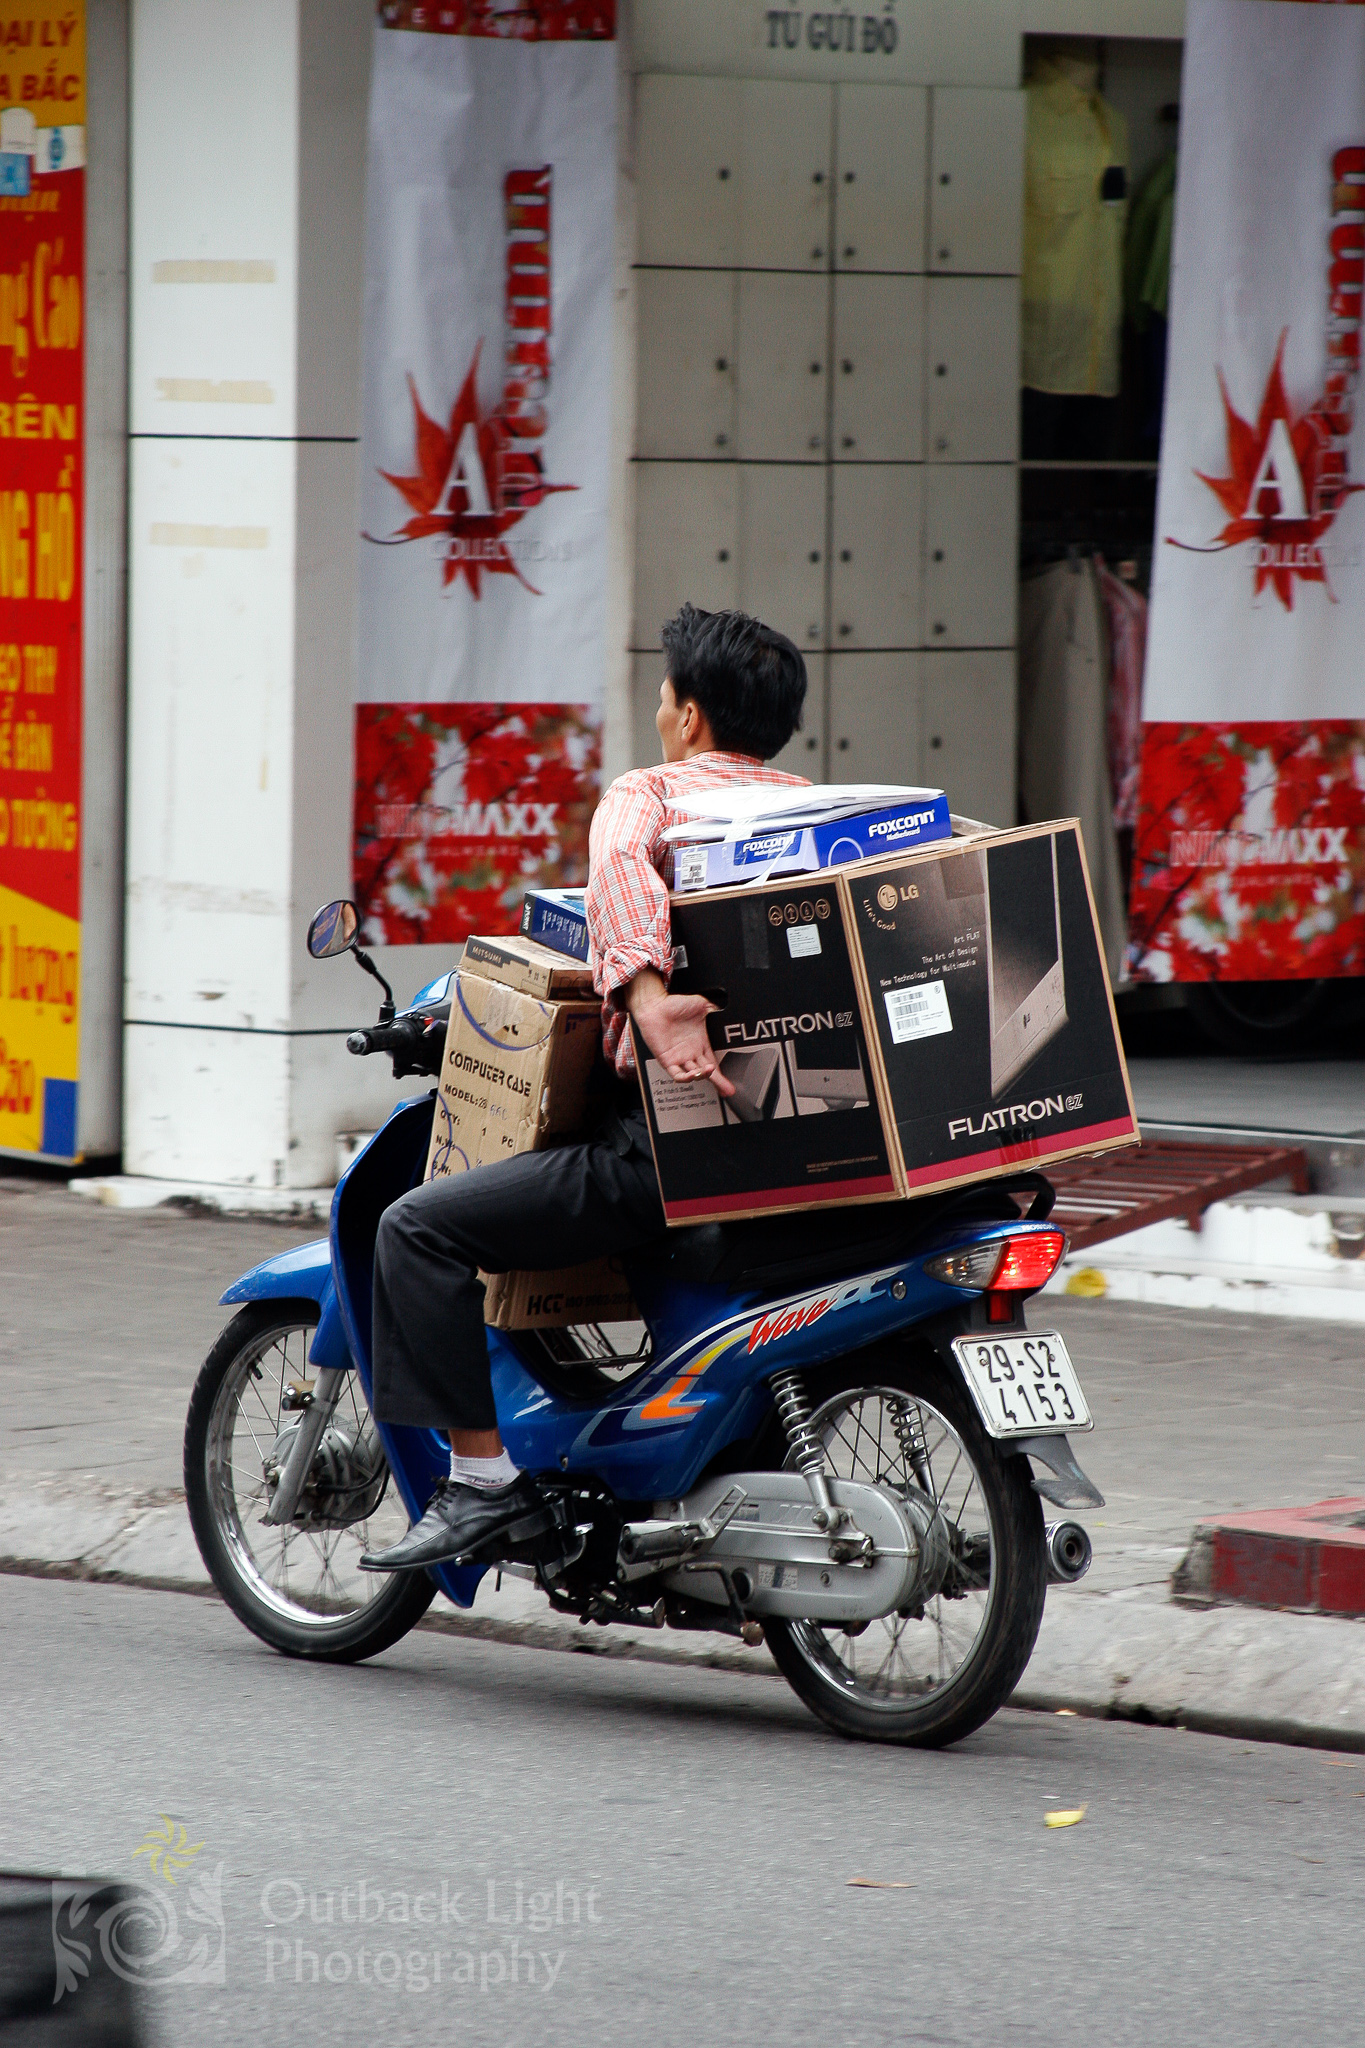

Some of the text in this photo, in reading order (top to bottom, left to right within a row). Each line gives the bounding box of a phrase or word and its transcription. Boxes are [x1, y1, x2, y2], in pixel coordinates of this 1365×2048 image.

[0, 11, 77, 55] ẠI LÝ
[20, 58, 80, 102] BẮC
[900, 884, 920, 901] LG
[876, 920, 897, 931] Good
[472, 946, 502, 964] MITSUMI
[921, 955, 932, 965] The
[935, 952, 946, 962] Art
[948, 950, 956, 960] of
[893, 970, 928, 985] Technology
[930, 966, 940, 976] for
[724, 1010, 834, 1044] FLATRON
[449, 1050, 532, 1097] COMPUTER CASE
[948, 1094, 1063, 1141] FLATRON
[482, 1127, 487, 1137] 1
[501, 1135, 514, 1148] PC
[748, 1298, 838, 1355] Wave
[976, 1340, 1060, 1384] 29-S2
[999, 1382, 1076, 1425] 4153
